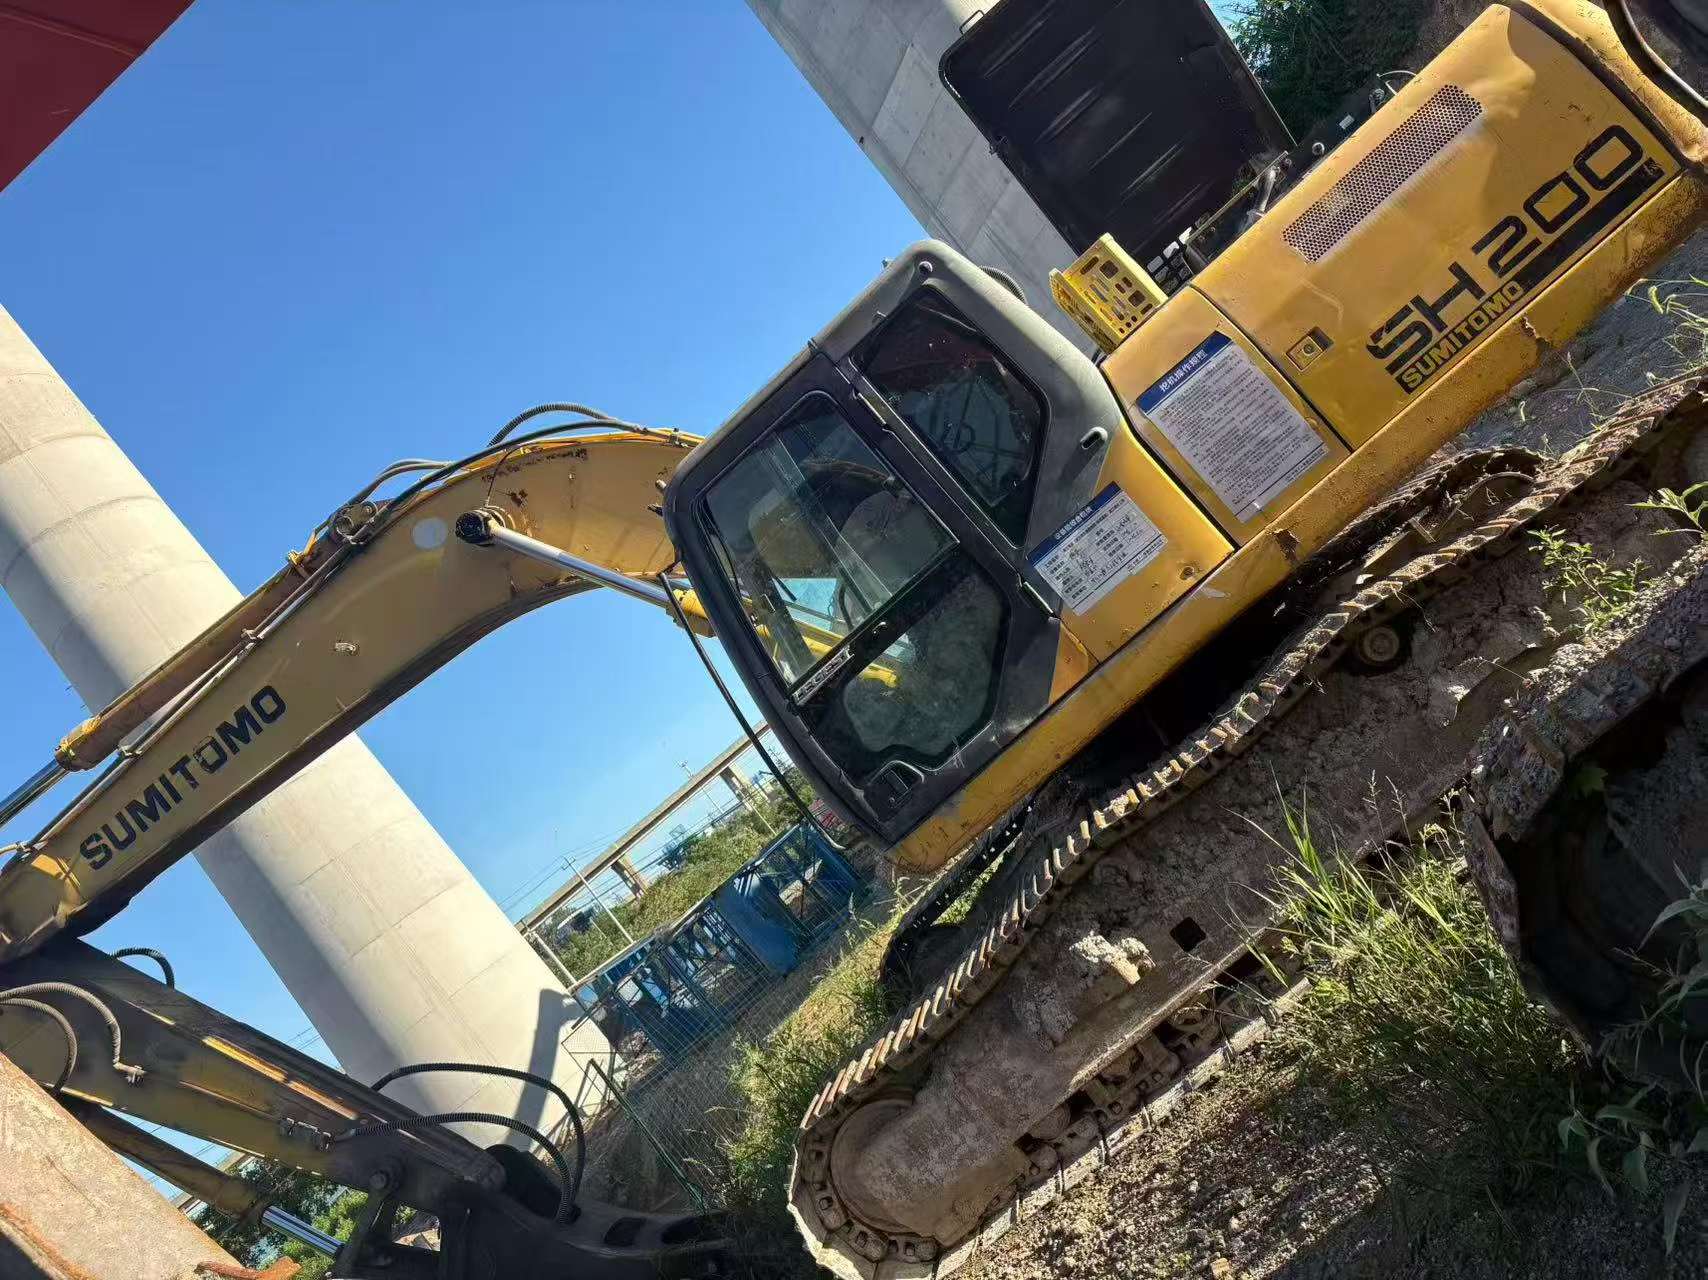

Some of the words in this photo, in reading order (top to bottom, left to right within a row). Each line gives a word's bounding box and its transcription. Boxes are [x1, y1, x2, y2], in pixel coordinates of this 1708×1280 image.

[1366, 262, 1486, 376] SH
[1471, 125, 1643, 278] 200
[1400, 279, 1525, 390] SUMITOMO
[79, 685, 287, 871] SUMITOMO
